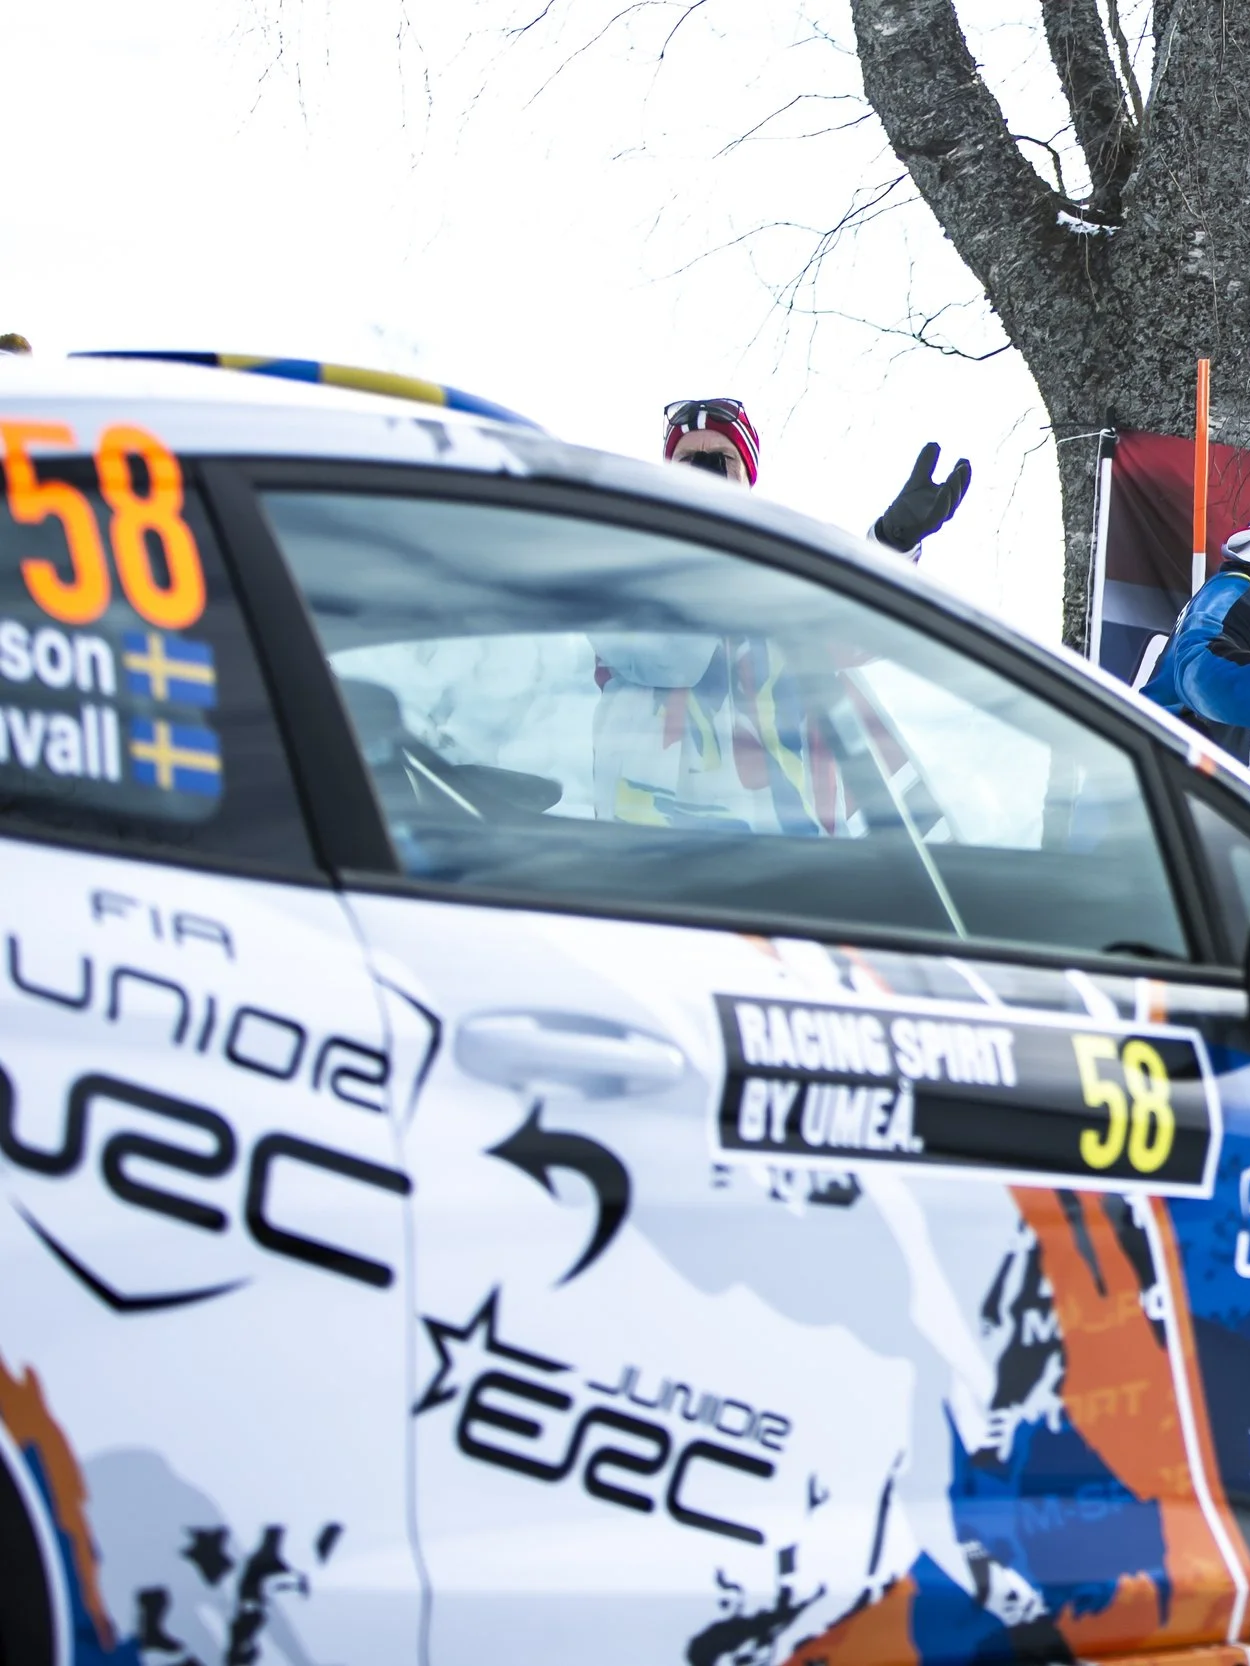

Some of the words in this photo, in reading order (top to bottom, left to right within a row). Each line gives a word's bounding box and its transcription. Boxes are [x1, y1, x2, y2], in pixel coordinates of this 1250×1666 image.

[0, 415, 206, 629] 58
[90, 887, 235, 960] FIA
[735, 1002, 892, 1077] RACING
[890, 1017, 1017, 1088] SPIRIT
[738, 1076, 800, 1144] BY
[801, 1070, 926, 1154] UMEÅ.
[1071, 1033, 1176, 1174] 58
[585, 1364, 794, 1452] JUNIOR
[456, 1369, 777, 1547] ERC
